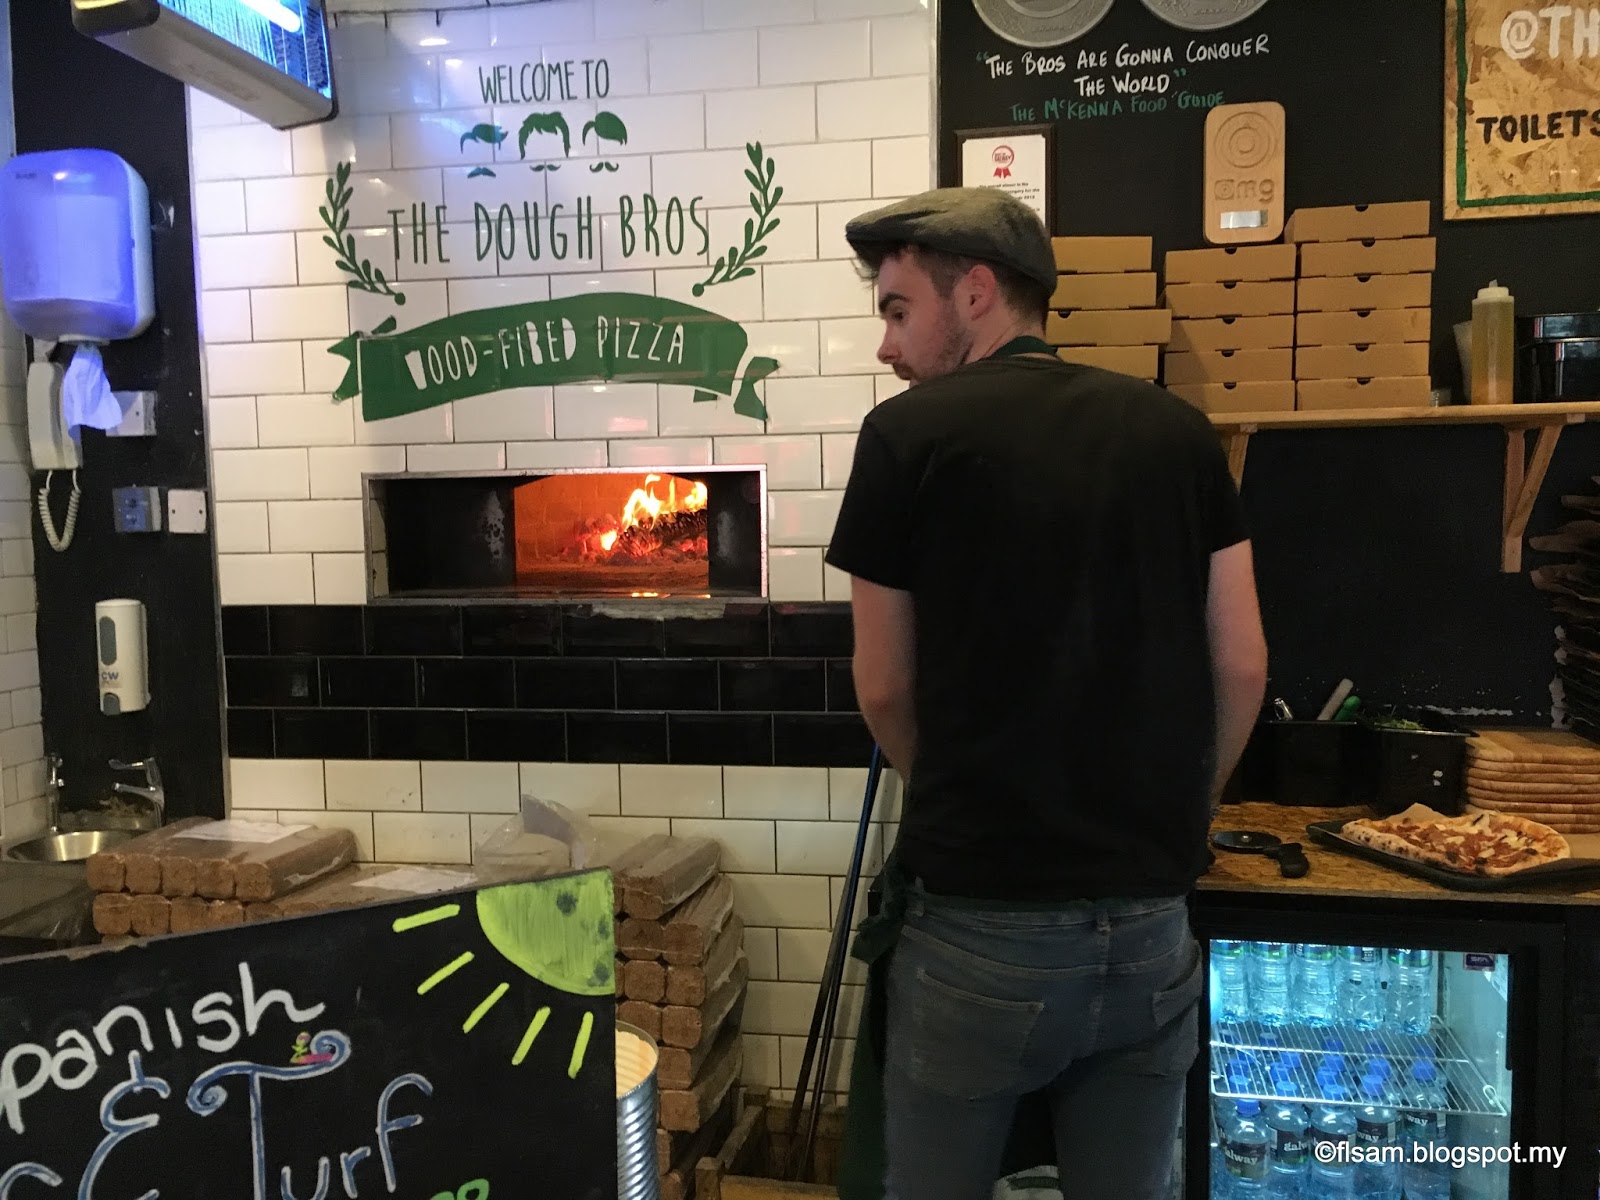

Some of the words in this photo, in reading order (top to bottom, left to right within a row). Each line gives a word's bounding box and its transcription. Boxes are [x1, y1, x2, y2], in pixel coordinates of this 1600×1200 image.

[1021, 51, 1066, 76] BROS
[1077, 49, 1107, 70] ARE
[1115, 43, 1174, 68] GONNA
[1186, 33, 1270, 63] CONQUER
[478, 62, 578, 104] WELCOME
[581, 58, 610, 99] TO
[1073, 75, 1106, 97] THE
[1009, 103, 1036, 121] THE
[1131, 95, 1167, 113] FOOD
[387, 201, 450, 264] THE
[474, 195, 593, 262] DOUGH
[619, 193, 709, 258] BROS
[597, 315, 684, 365] PIZZA
[0, 961, 327, 1134] panish
[186, 1029, 434, 1200] Turf
